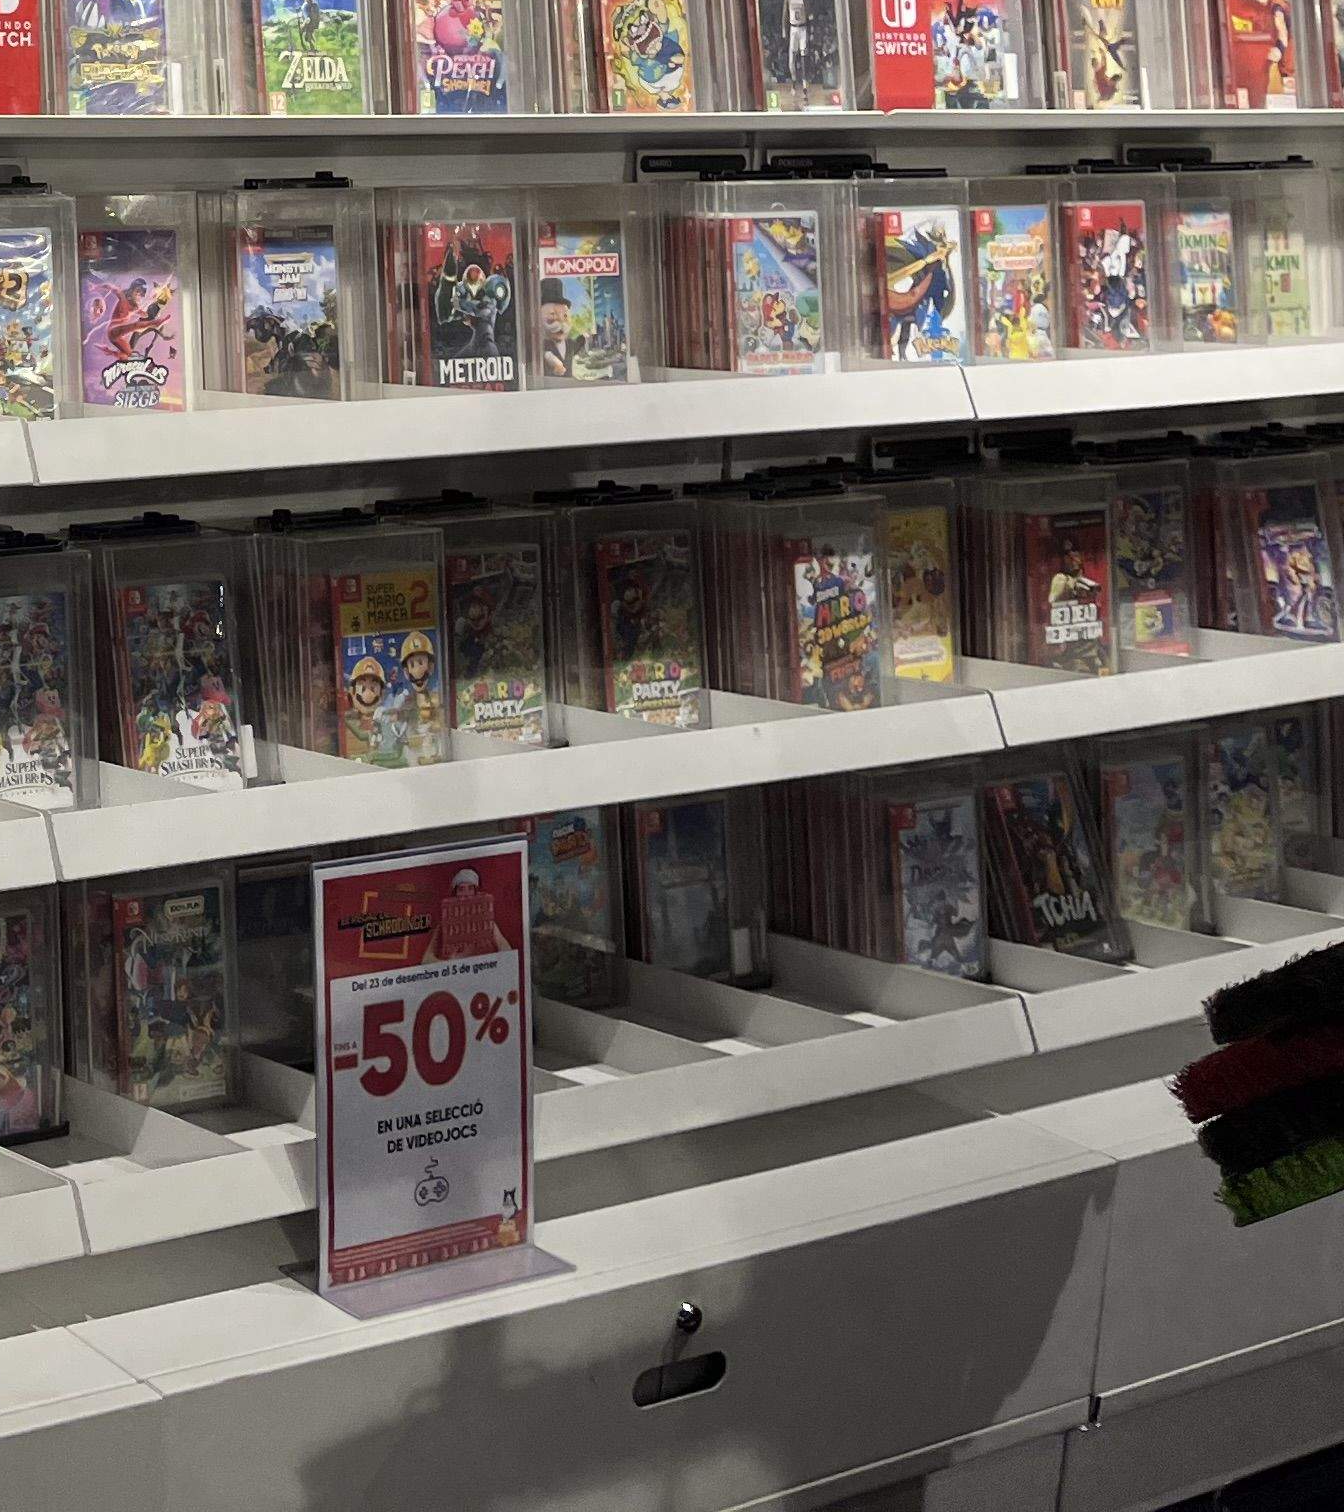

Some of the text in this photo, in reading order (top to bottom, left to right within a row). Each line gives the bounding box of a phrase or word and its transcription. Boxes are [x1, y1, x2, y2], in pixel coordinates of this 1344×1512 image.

[875, 41, 927, 56] SWITCH
[278, 50, 349, 89] ZELDA
[545, 254, 619, 276] MONOPOLY
[439, 358, 515, 385] METROID
[175, 747, 207, 761] SUPER
[4, 761, 37, 776] SUPER
[352, 978, 368, 992] Del
[369, 977, 381, 988] 23
[381, 975, 394, 987] de
[395, 969, 440, 985] desembre
[377, 1098, 484, 1135] EN UNA SELECCIÓ
[387, 1123, 478, 1154] DE VIDEOJOCS
